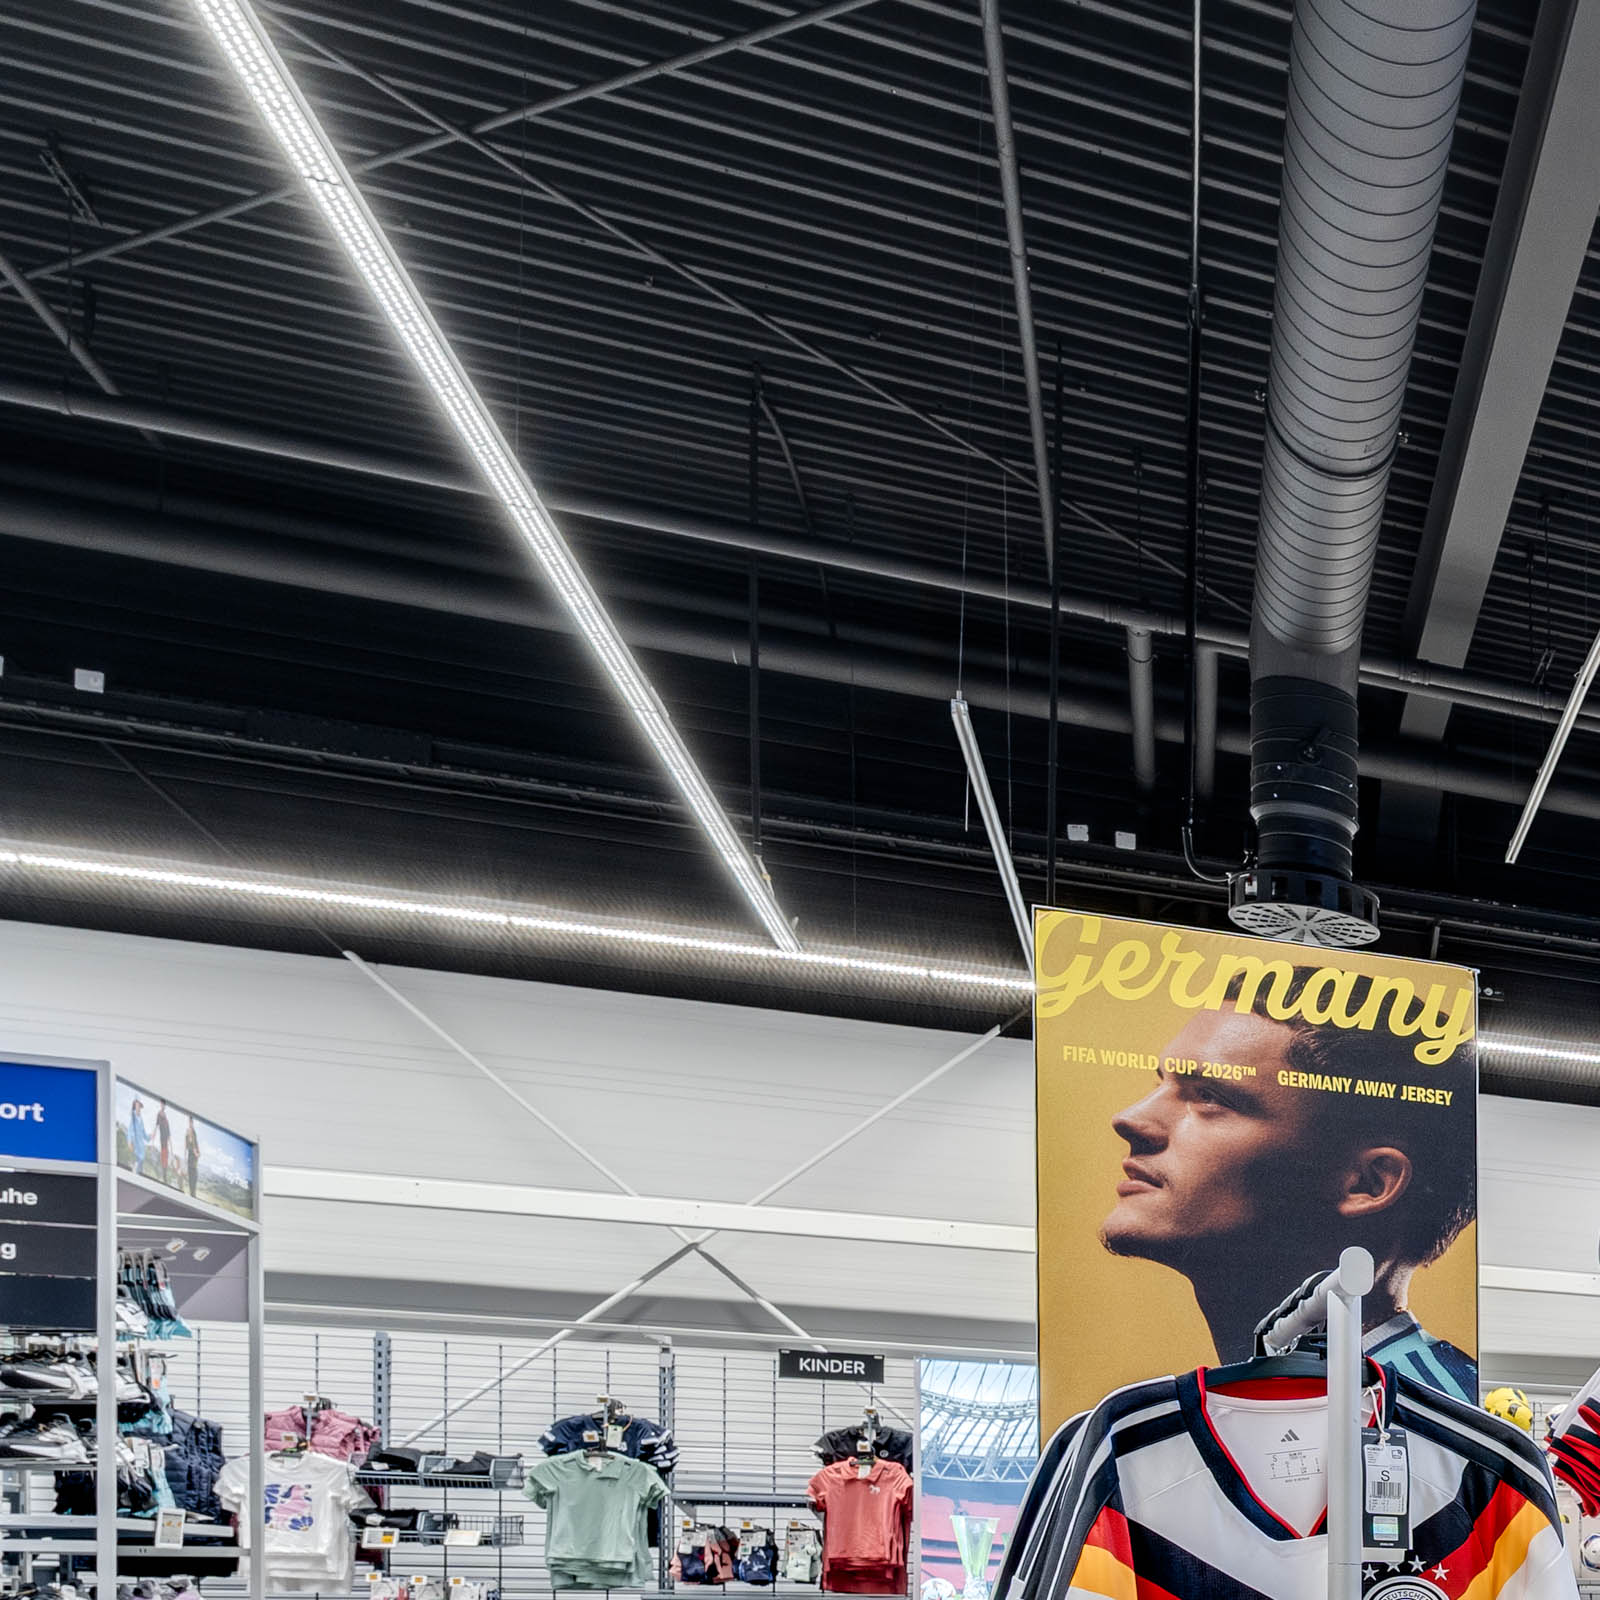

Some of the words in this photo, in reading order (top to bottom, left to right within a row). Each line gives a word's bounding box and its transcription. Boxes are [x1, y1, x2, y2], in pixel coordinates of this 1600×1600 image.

[1036, 911, 1475, 1066] Germany
[1063, 1045, 1097, 1064] FIFA
[1100, 1050, 1159, 1071] WORLD
[1164, 1058, 1198, 1076] CUP
[1277, 1070, 1352, 1095] GERMANY
[1355, 1081, 1397, 1100] AWAY
[1400, 1084, 1453, 1107] JERSEY
[799, 1357, 866, 1376] KINDER
[1380, 1470, 1390, 1482] S
